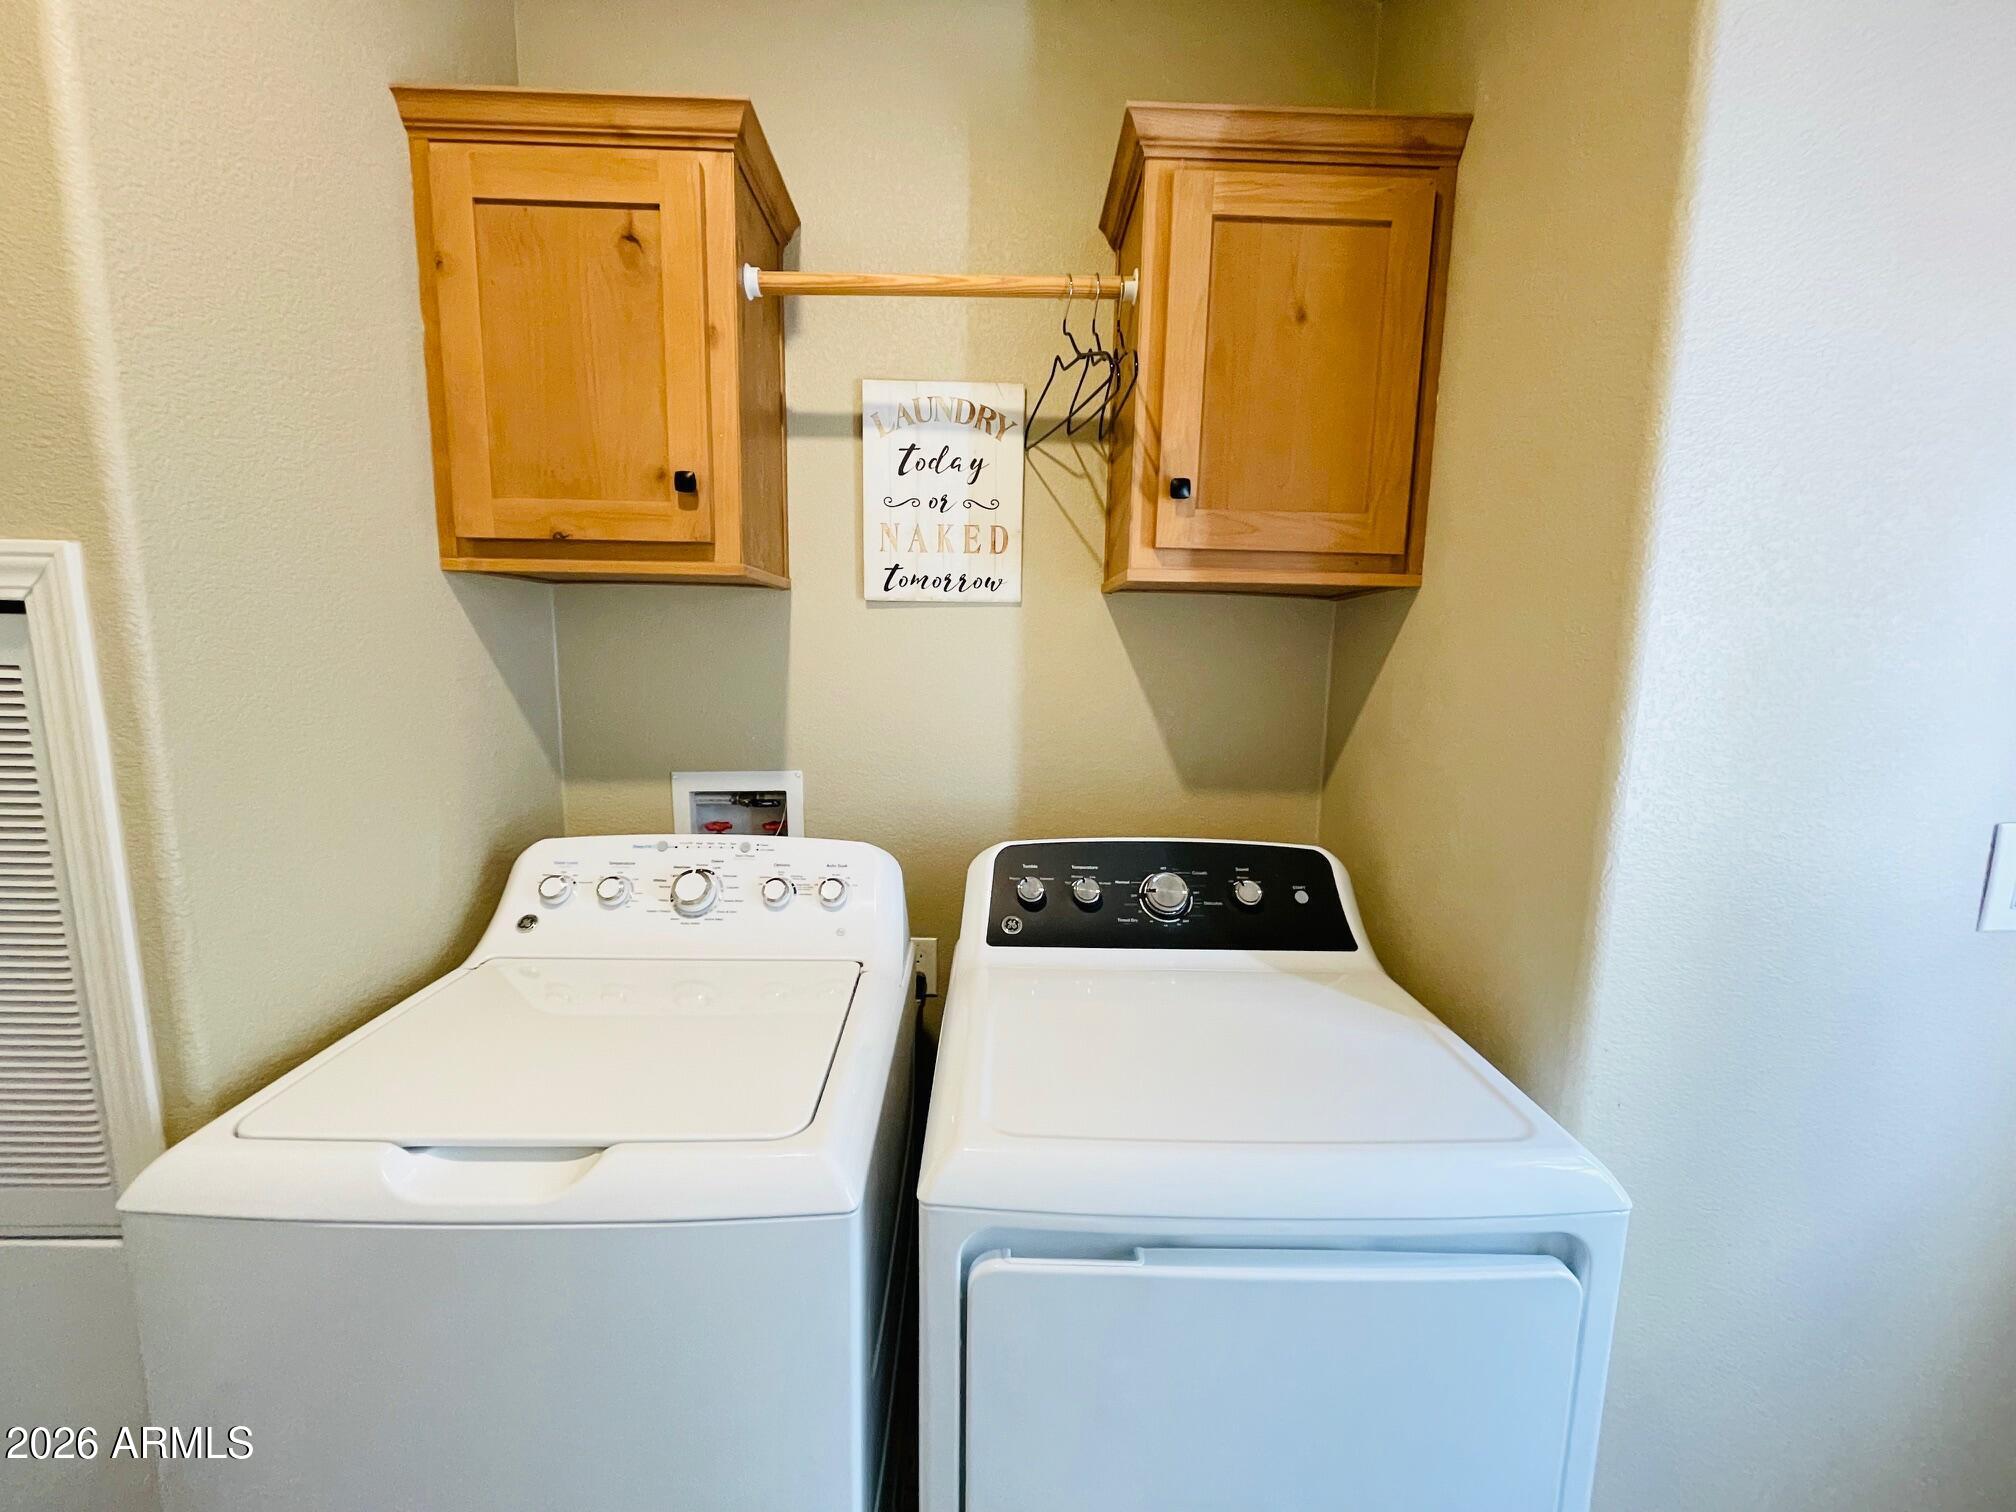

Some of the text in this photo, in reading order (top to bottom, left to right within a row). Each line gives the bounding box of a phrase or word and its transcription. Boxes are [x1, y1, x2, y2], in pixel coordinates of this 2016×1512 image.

[870, 396, 1018, 442] LAUNDRY
[898, 443, 990, 485] today
[928, 494, 957, 513] or
[879, 522, 1009, 555] NAKED
[883, 563, 1007, 592] tomorrow
